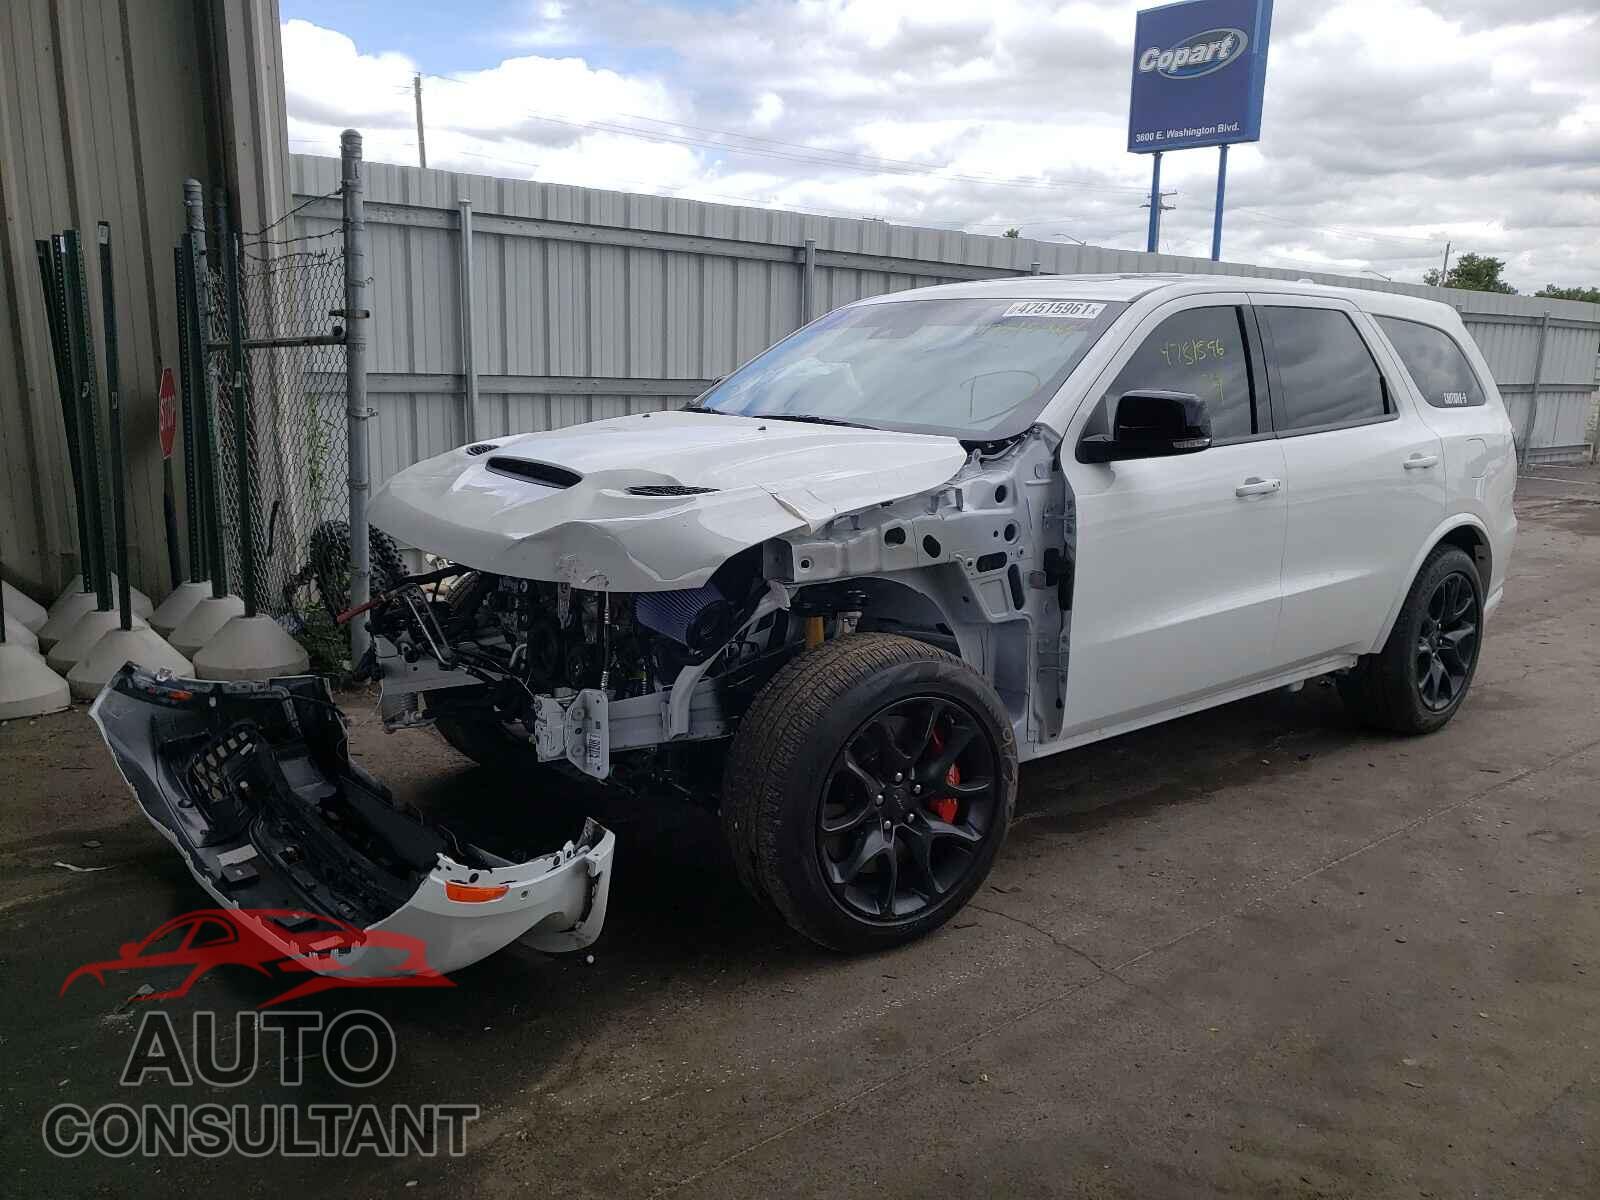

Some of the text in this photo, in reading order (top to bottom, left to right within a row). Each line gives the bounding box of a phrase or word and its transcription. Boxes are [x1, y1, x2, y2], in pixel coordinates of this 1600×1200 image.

[1138, 32, 1235, 73] Copart
[1156, 131, 1165, 140] E.
[1166, 125, 1215, 139] Washington
[1217, 121, 1240, 133] Blvd.
[161, 395, 176, 431] STOP
